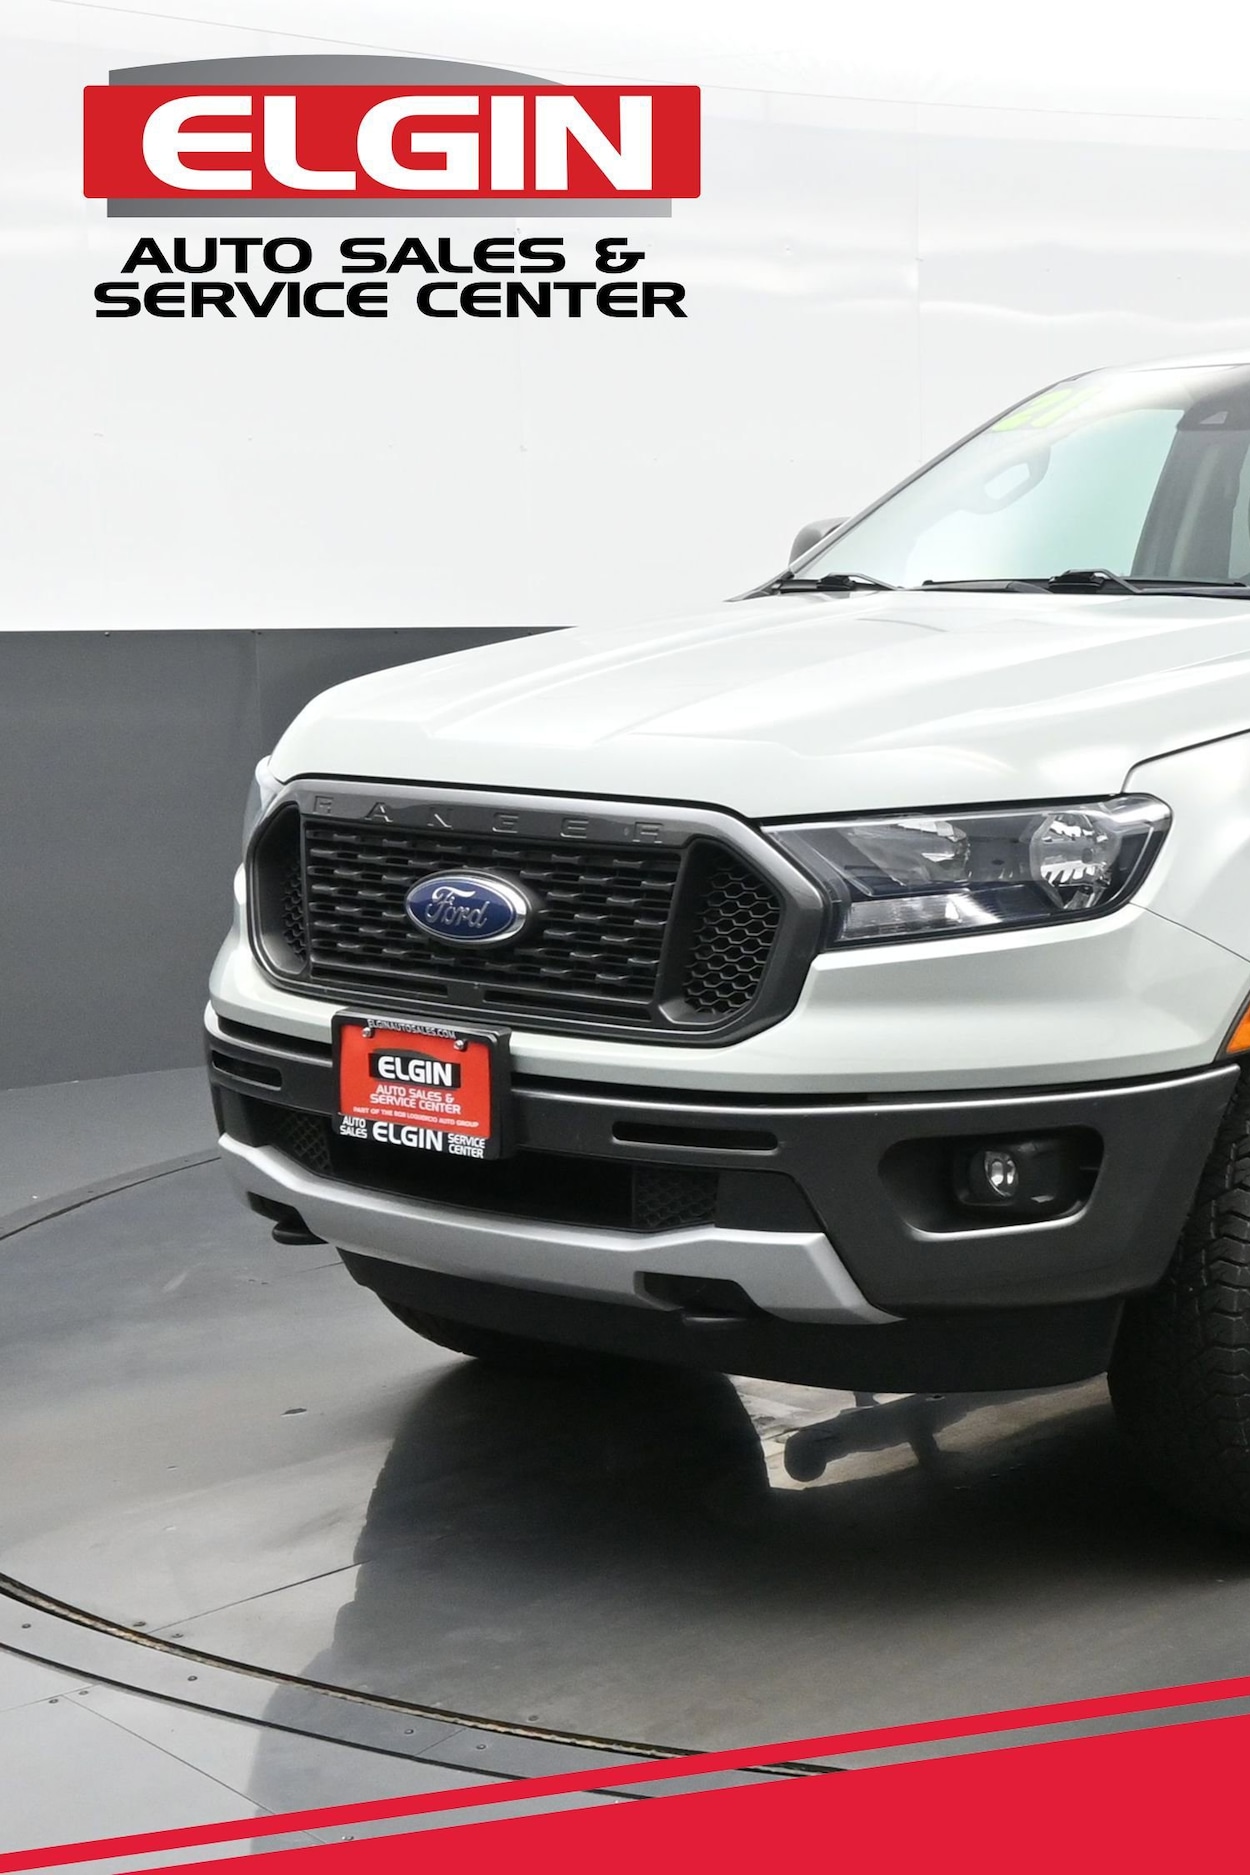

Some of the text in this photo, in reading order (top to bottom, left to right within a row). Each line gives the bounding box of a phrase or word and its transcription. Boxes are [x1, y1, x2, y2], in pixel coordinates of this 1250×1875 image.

[313, 795, 663, 844] RANGER
[424, 886, 490, 928] Ford
[367, 1018, 456, 1039] ELGINAUTOSALES.COM
[378, 1056, 452, 1086] ELGIN
[369, 1093, 461, 1115] SERVICE CENTER
[375, 1084, 455, 1104] AUTO SALES &
[342, 1116, 366, 1128] AUTO
[353, 1106, 369, 1115] PART
[438, 1117, 455, 1125] AUTO
[456, 1119, 479, 1128] GROUP
[339, 1125, 368, 1139] SALES
[372, 1121, 443, 1152] ELGIN
[447, 1133, 485, 1149] SERVICE
[448, 1143, 484, 1159] CENTER
